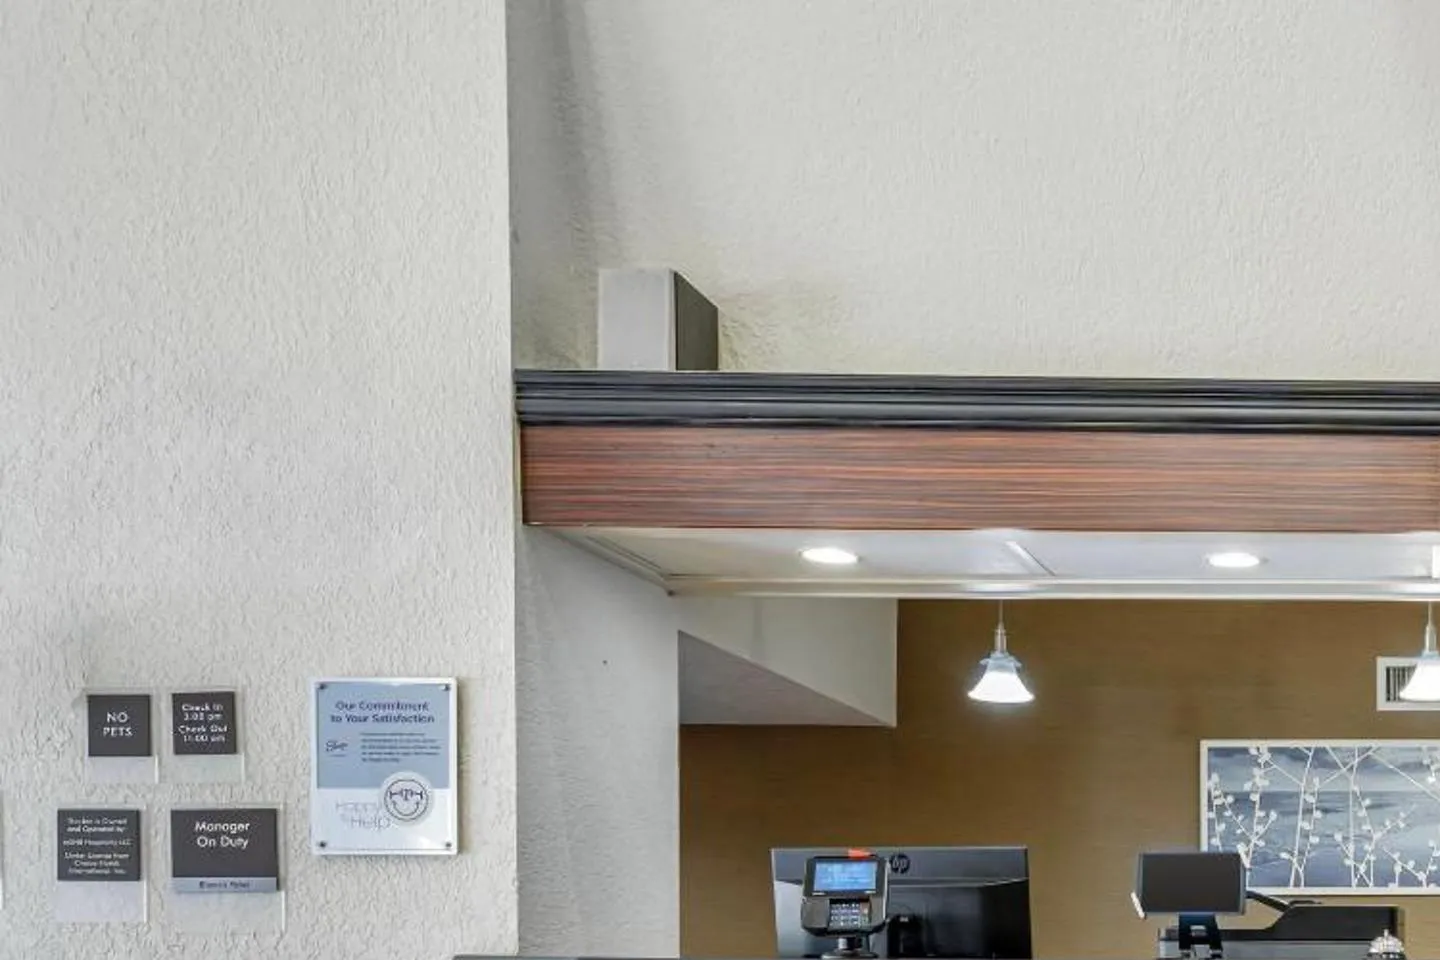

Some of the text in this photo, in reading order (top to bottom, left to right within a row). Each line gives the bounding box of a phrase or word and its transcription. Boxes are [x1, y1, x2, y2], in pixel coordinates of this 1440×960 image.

[335, 701, 430, 711] Our Commitment
[106, 711, 129, 723] NO
[330, 713, 435, 723] to Your Satisfaction
[103, 727, 134, 737] PETS
[195, 821, 250, 834] Manager
[196, 836, 248, 849] On Duty
